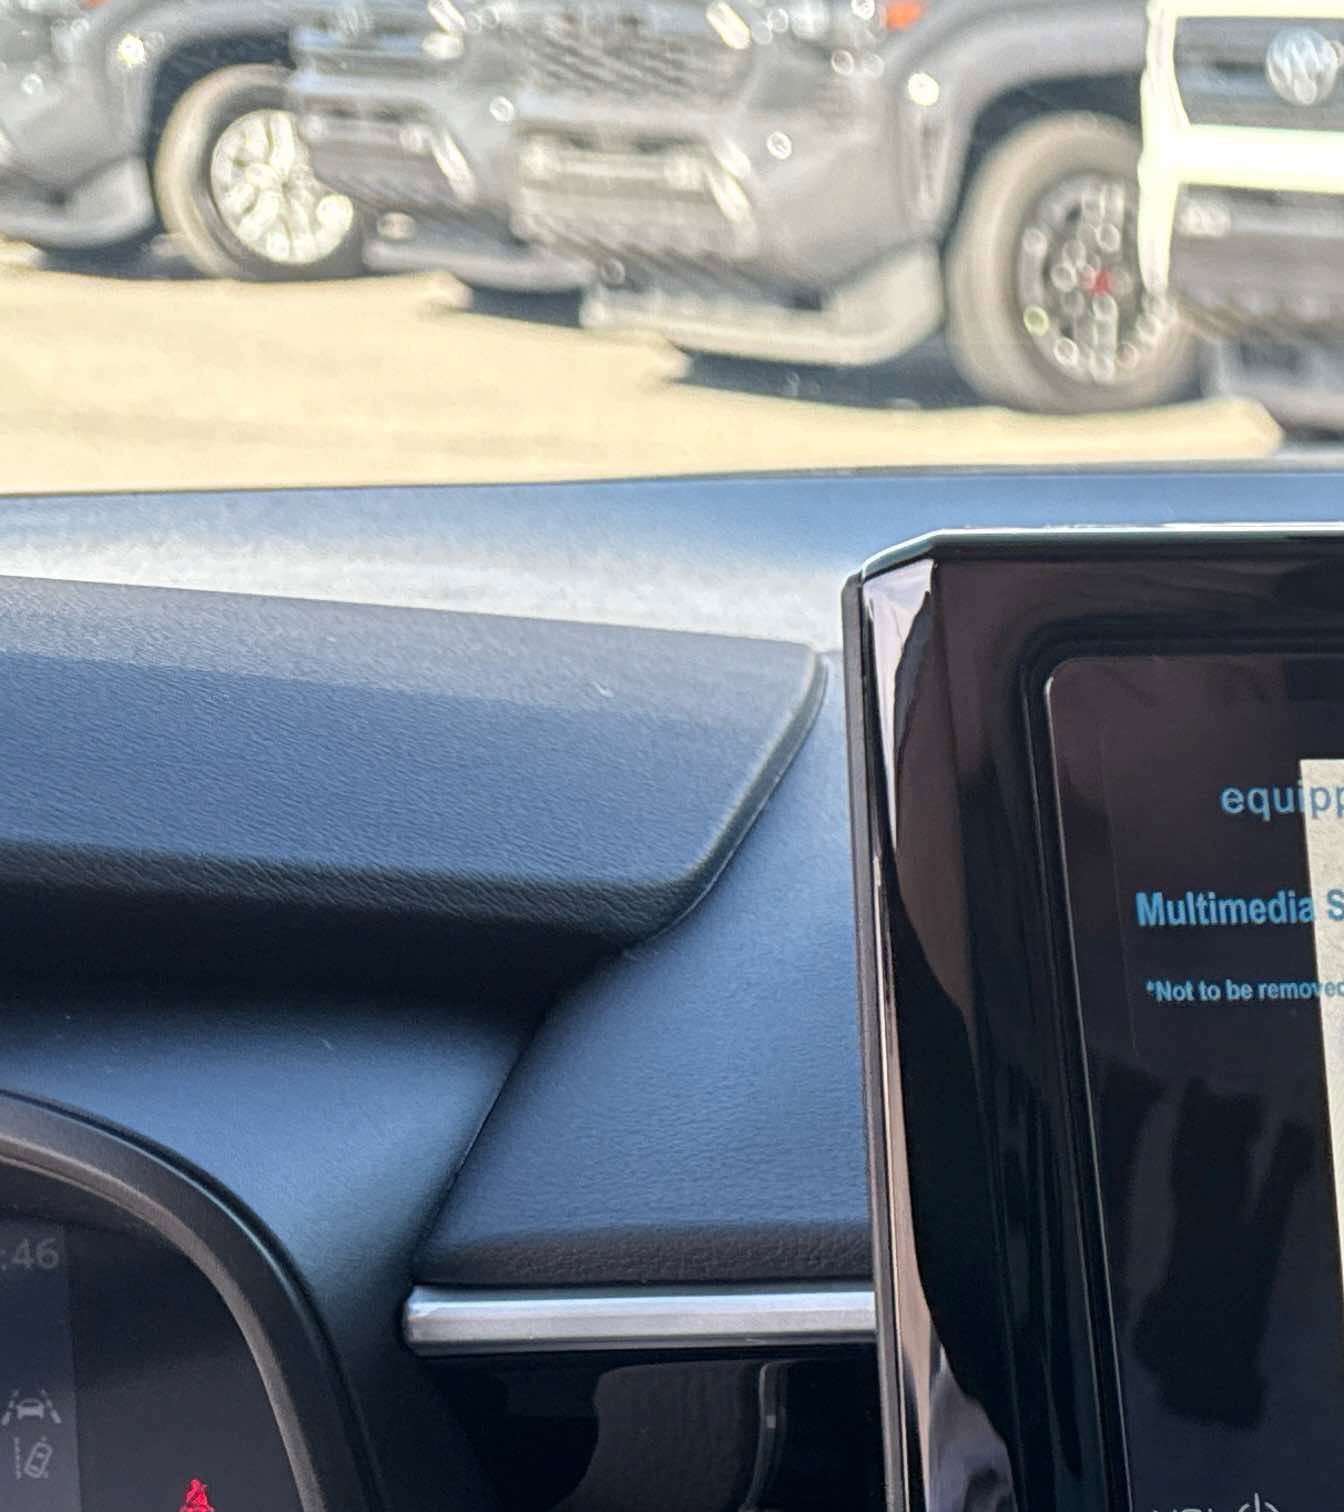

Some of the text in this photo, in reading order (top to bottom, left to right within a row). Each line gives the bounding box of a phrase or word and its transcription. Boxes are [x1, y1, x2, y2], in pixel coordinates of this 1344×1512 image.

[1136, 891, 1314, 926] Multimedia
[1200, 980, 1220, 1000] to
[1225, 979, 1253, 1000] be
